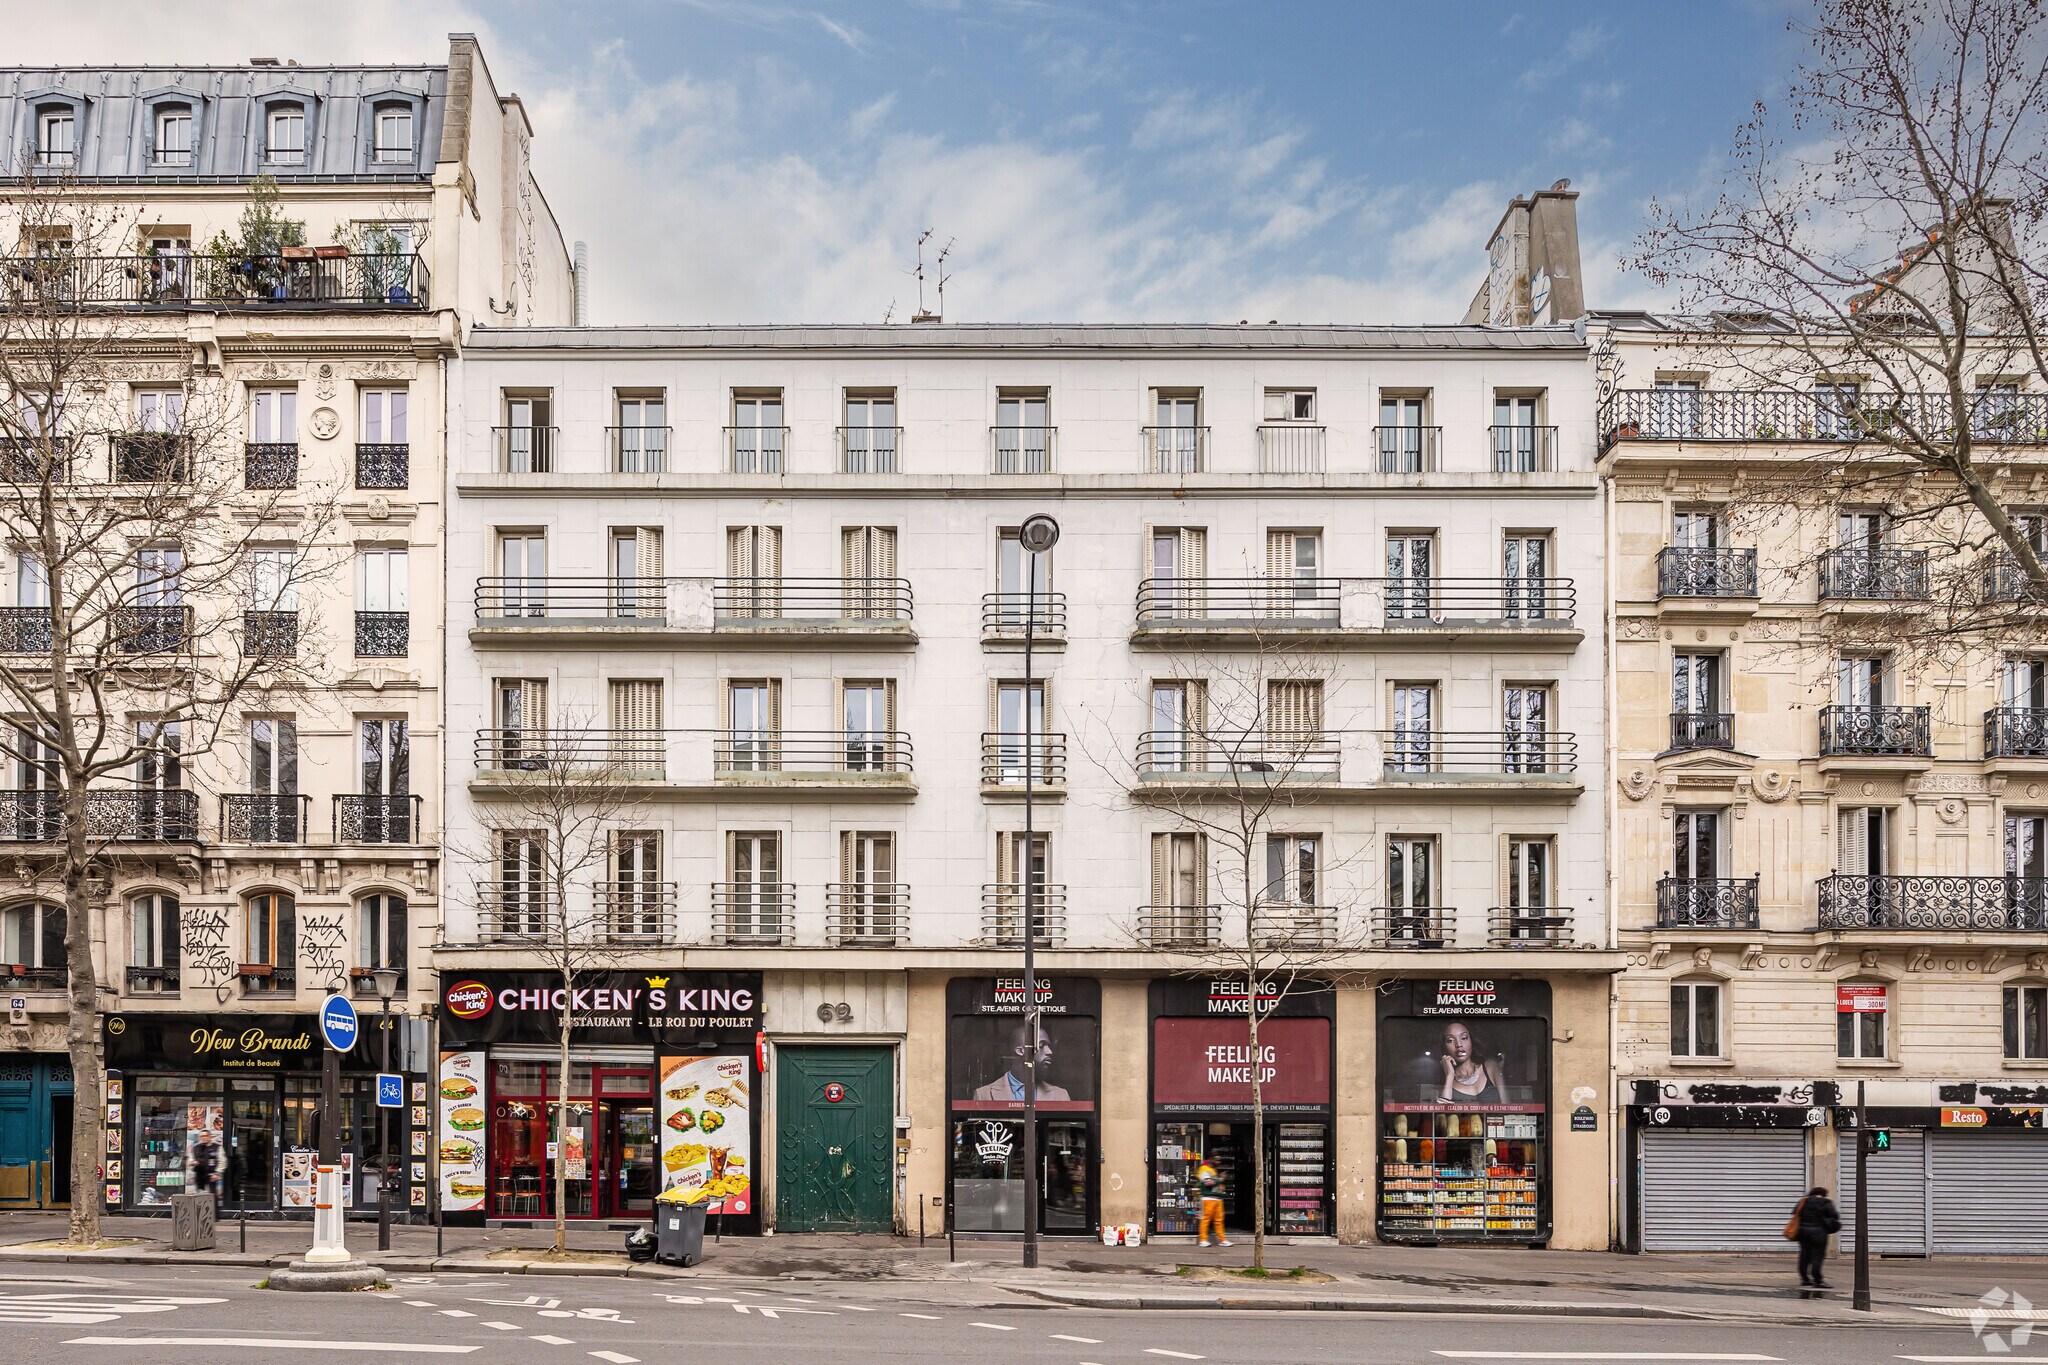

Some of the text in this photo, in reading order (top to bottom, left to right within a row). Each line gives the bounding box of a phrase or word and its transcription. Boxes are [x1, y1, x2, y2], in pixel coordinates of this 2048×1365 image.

[996, 978, 1051, 990] FEELNG
[1210, 981, 1277, 995] FEELNG
[1439, 980, 1495, 991] FEELING
[448, 990, 488, 1003] Chicken's
[679, 988, 754, 1012] KING
[994, 992, 1053, 1004] MAK UP
[1436, 993, 1497, 1006] MAKE UP
[12, 999, 24, 1008] 64
[465, 999, 486, 1010] King
[1022, 1005, 1067, 1013] CSETIQUE
[1208, 999, 1279, 1013] MAKE UP
[558, 1016, 633, 1028] RSTAURANT
[648, 1017, 663, 1028] LE
[665, 1017, 687, 1028] ROI
[689, 1017, 706, 1028] DU
[708, 1017, 754, 1028] POULET
[190, 1028, 312, 1054] New Brandi
[222, 1059, 281, 1067] Institut de Beauté
[678, 1057, 694, 1067] CHICKEN
[716, 1062, 743, 1072] Chicken's
[1656, 1111, 1669, 1120] 60
[1808, 1111, 1820, 1121] 60
[1951, 1110, 1983, 1124] Resto
[979, 1145, 1009, 1154] FEELING
[676, 1171, 702, 1185] Chicken's
[688, 1178, 703, 1187] King
